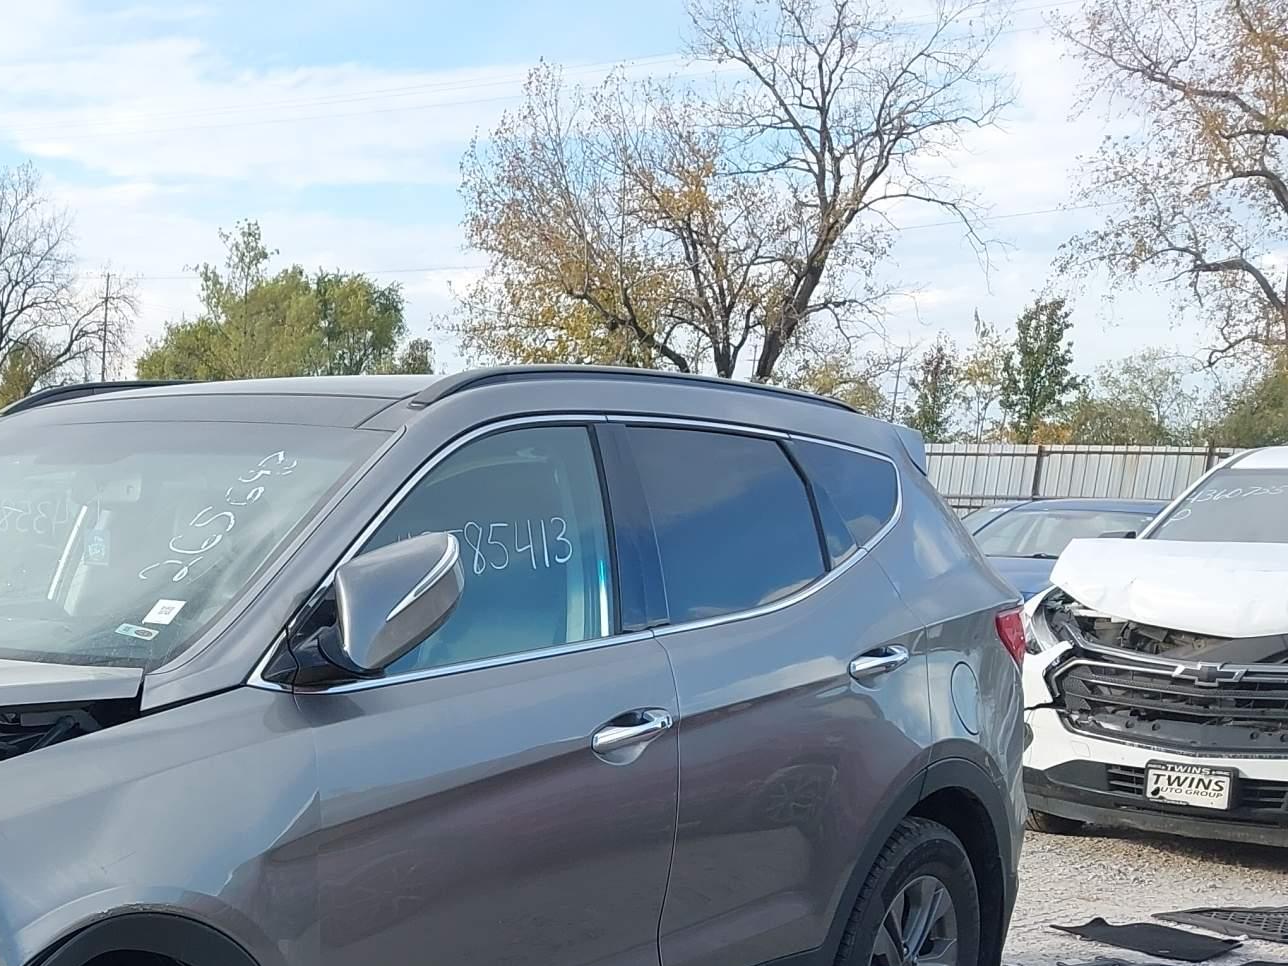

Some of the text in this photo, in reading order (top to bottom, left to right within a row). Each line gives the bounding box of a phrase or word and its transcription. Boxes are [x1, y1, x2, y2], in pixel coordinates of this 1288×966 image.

[1165, 763, 1211, 775] TWINS
[1152, 773, 1226, 792] TWINS
[1151, 786, 1223, 799] UTO GROUP
